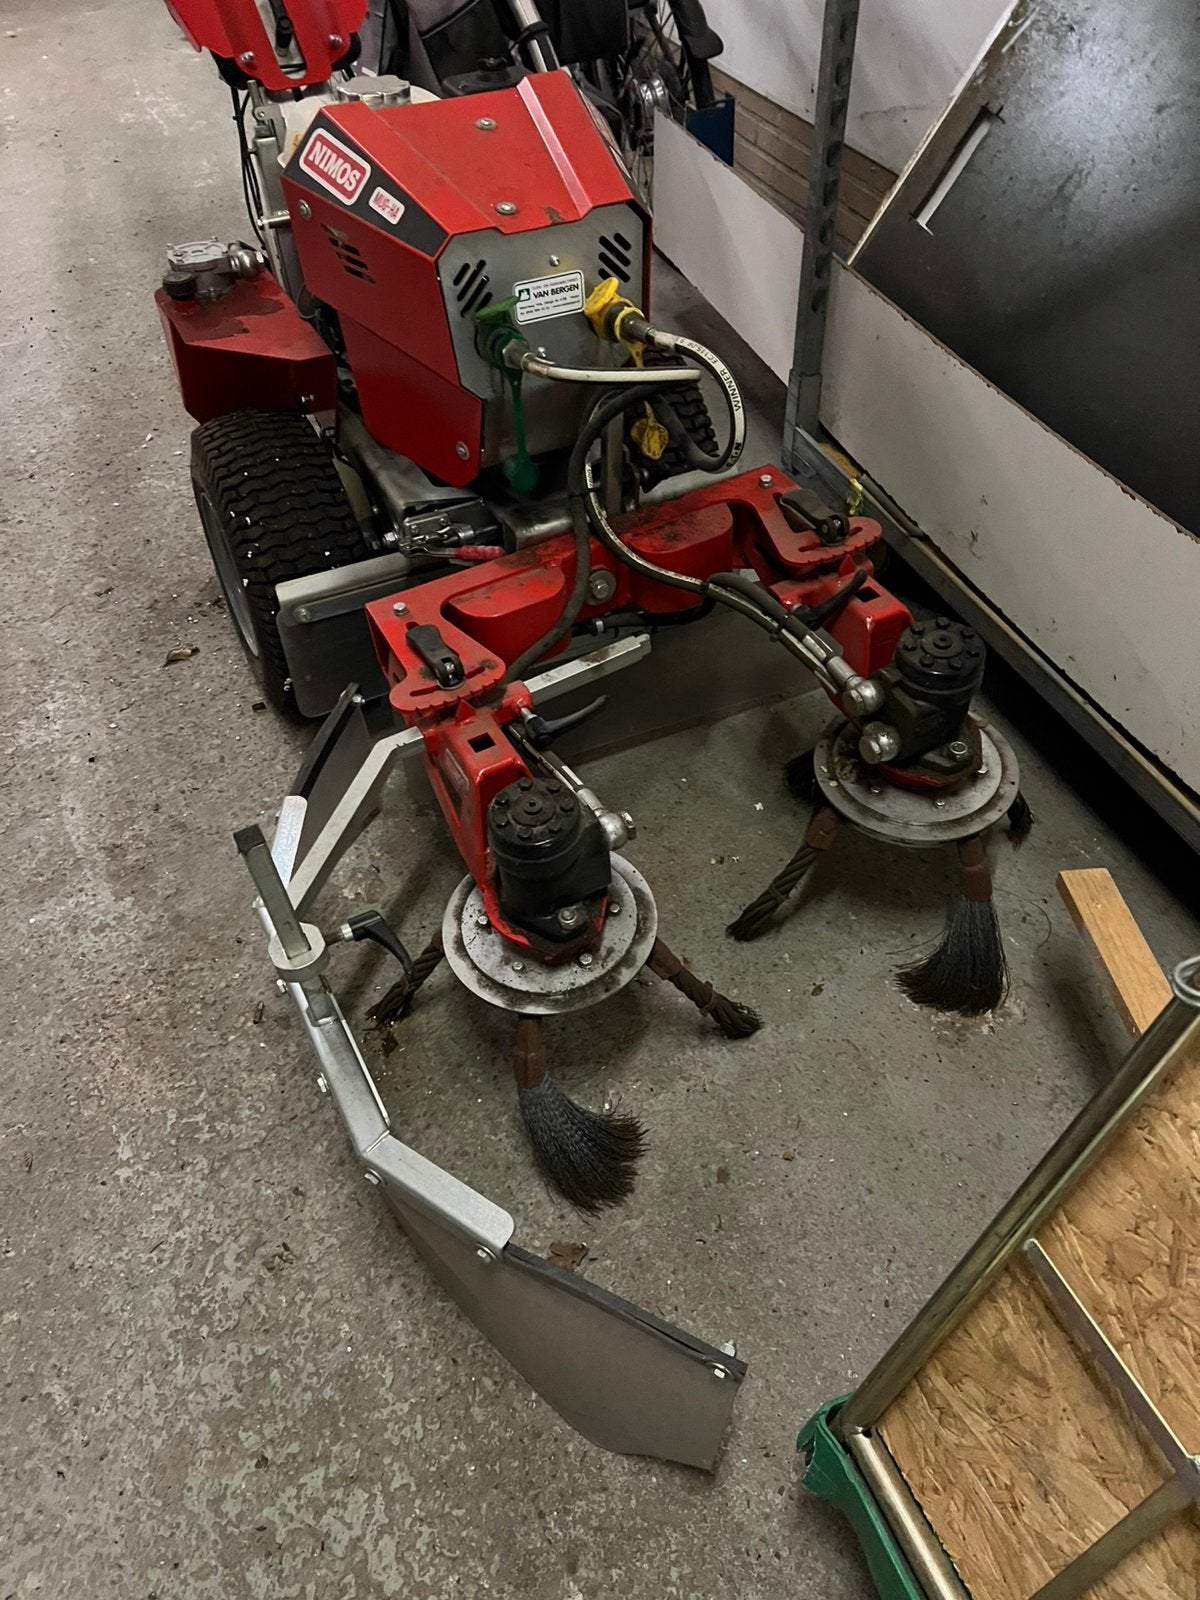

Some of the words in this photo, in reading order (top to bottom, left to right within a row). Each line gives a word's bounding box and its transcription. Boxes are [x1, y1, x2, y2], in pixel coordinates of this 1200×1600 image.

[308, 140, 361, 192] NIMOS
[532, 289, 549, 299] VAN
[550, 283, 579, 296] BERGEN
[719, 368, 742, 412] WINNER
